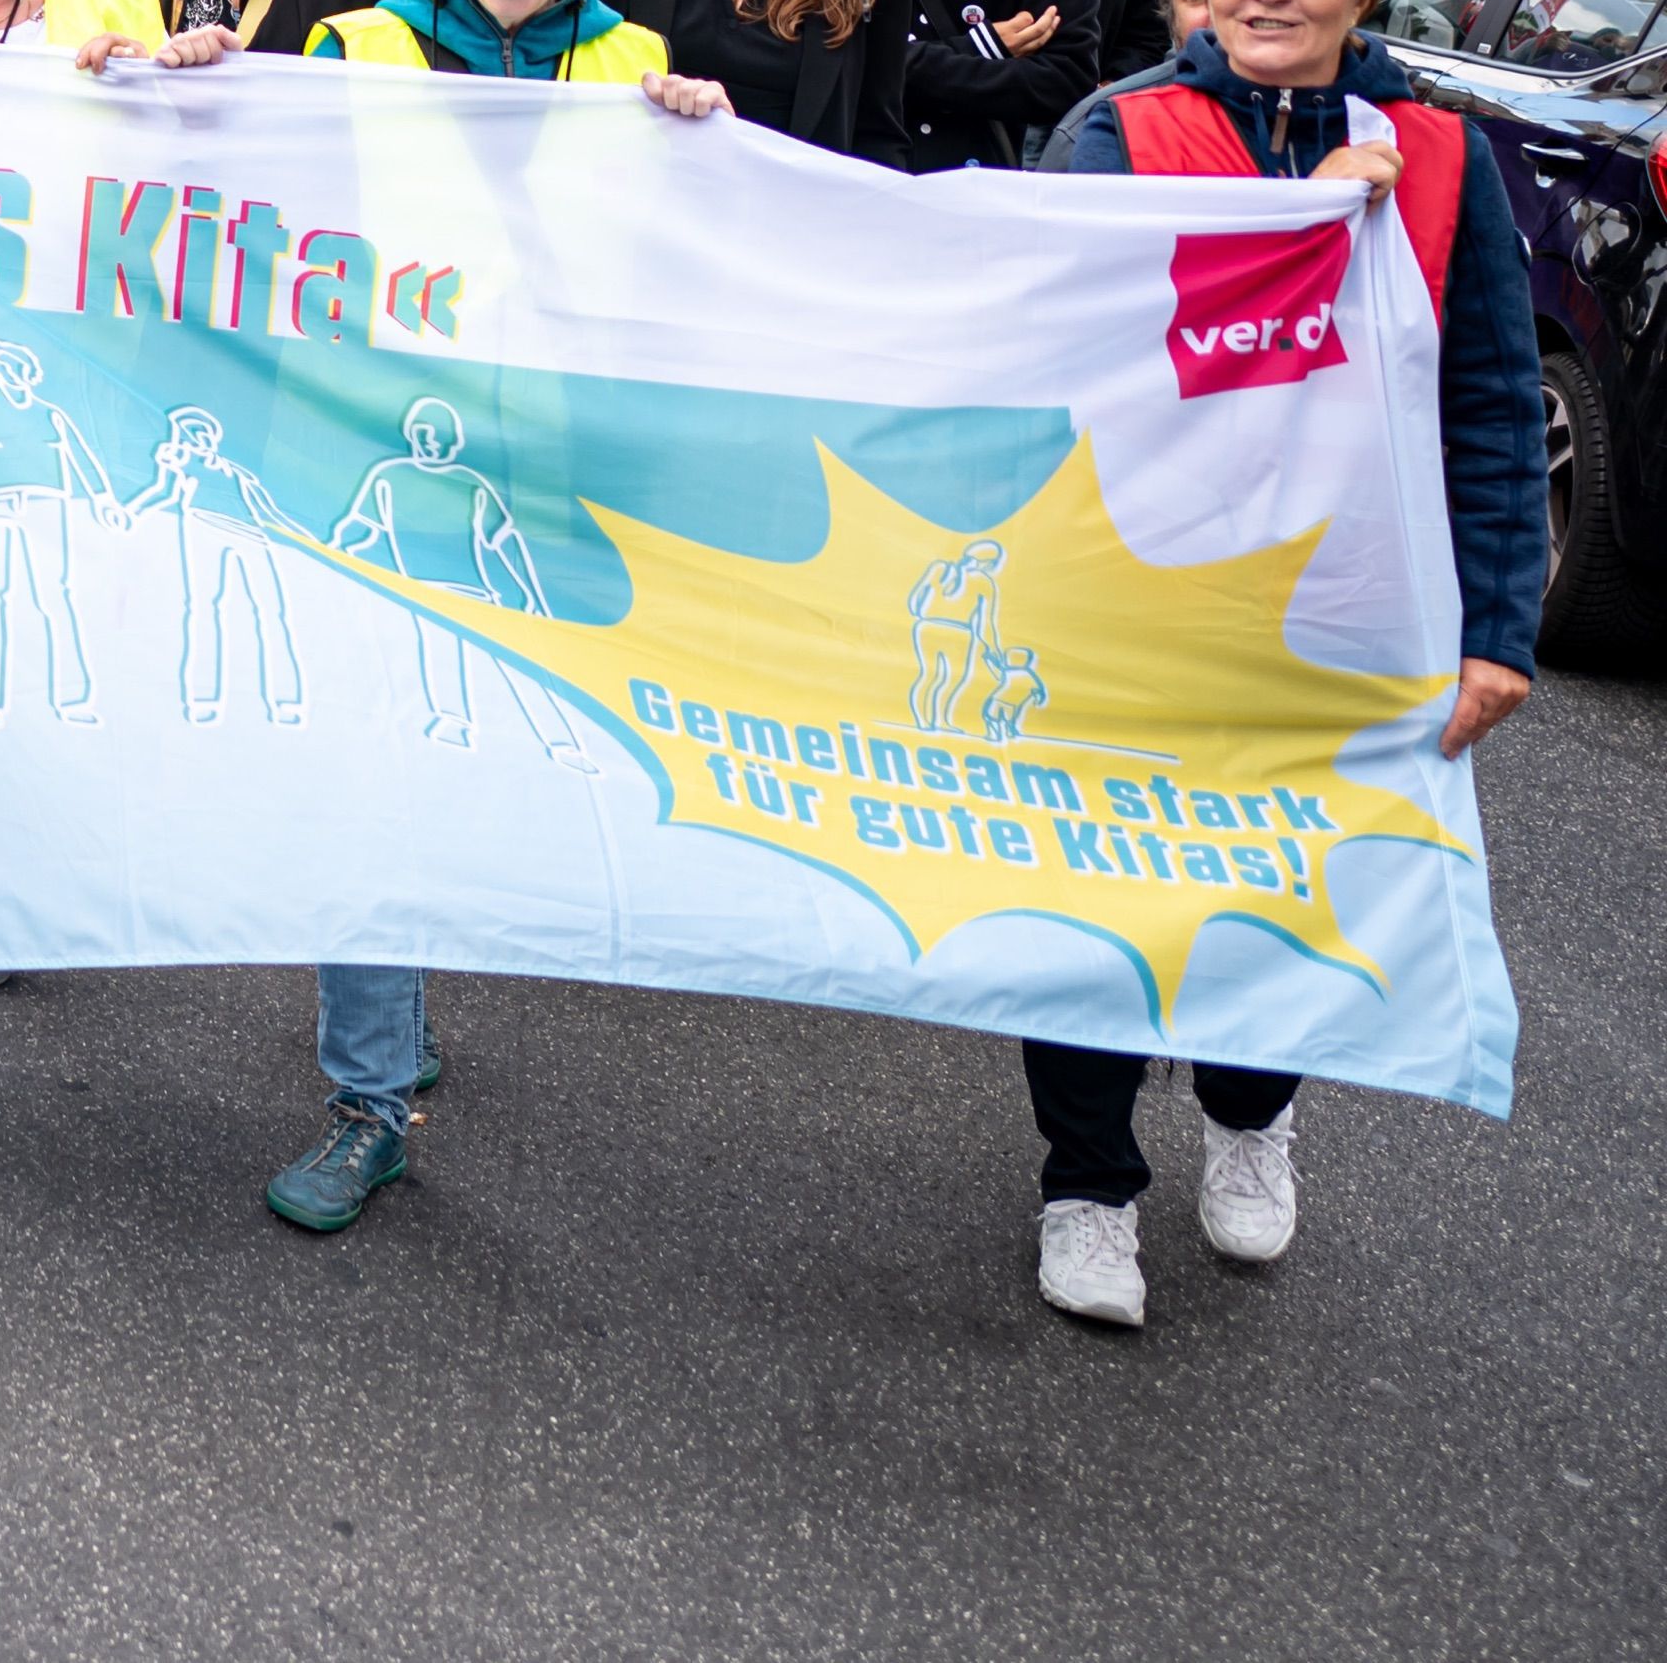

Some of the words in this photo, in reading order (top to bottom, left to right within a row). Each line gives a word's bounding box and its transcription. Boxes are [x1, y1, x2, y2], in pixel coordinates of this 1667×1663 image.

[1179, 302, 1332, 356] ver.d
[628, 677, 1085, 814] Gemeinsam
[1103, 773, 1342, 835] stark
[705, 750, 824, 827] für
[850, 793, 1039, 869] gute
[1057, 817, 1315, 903] Kitas!
